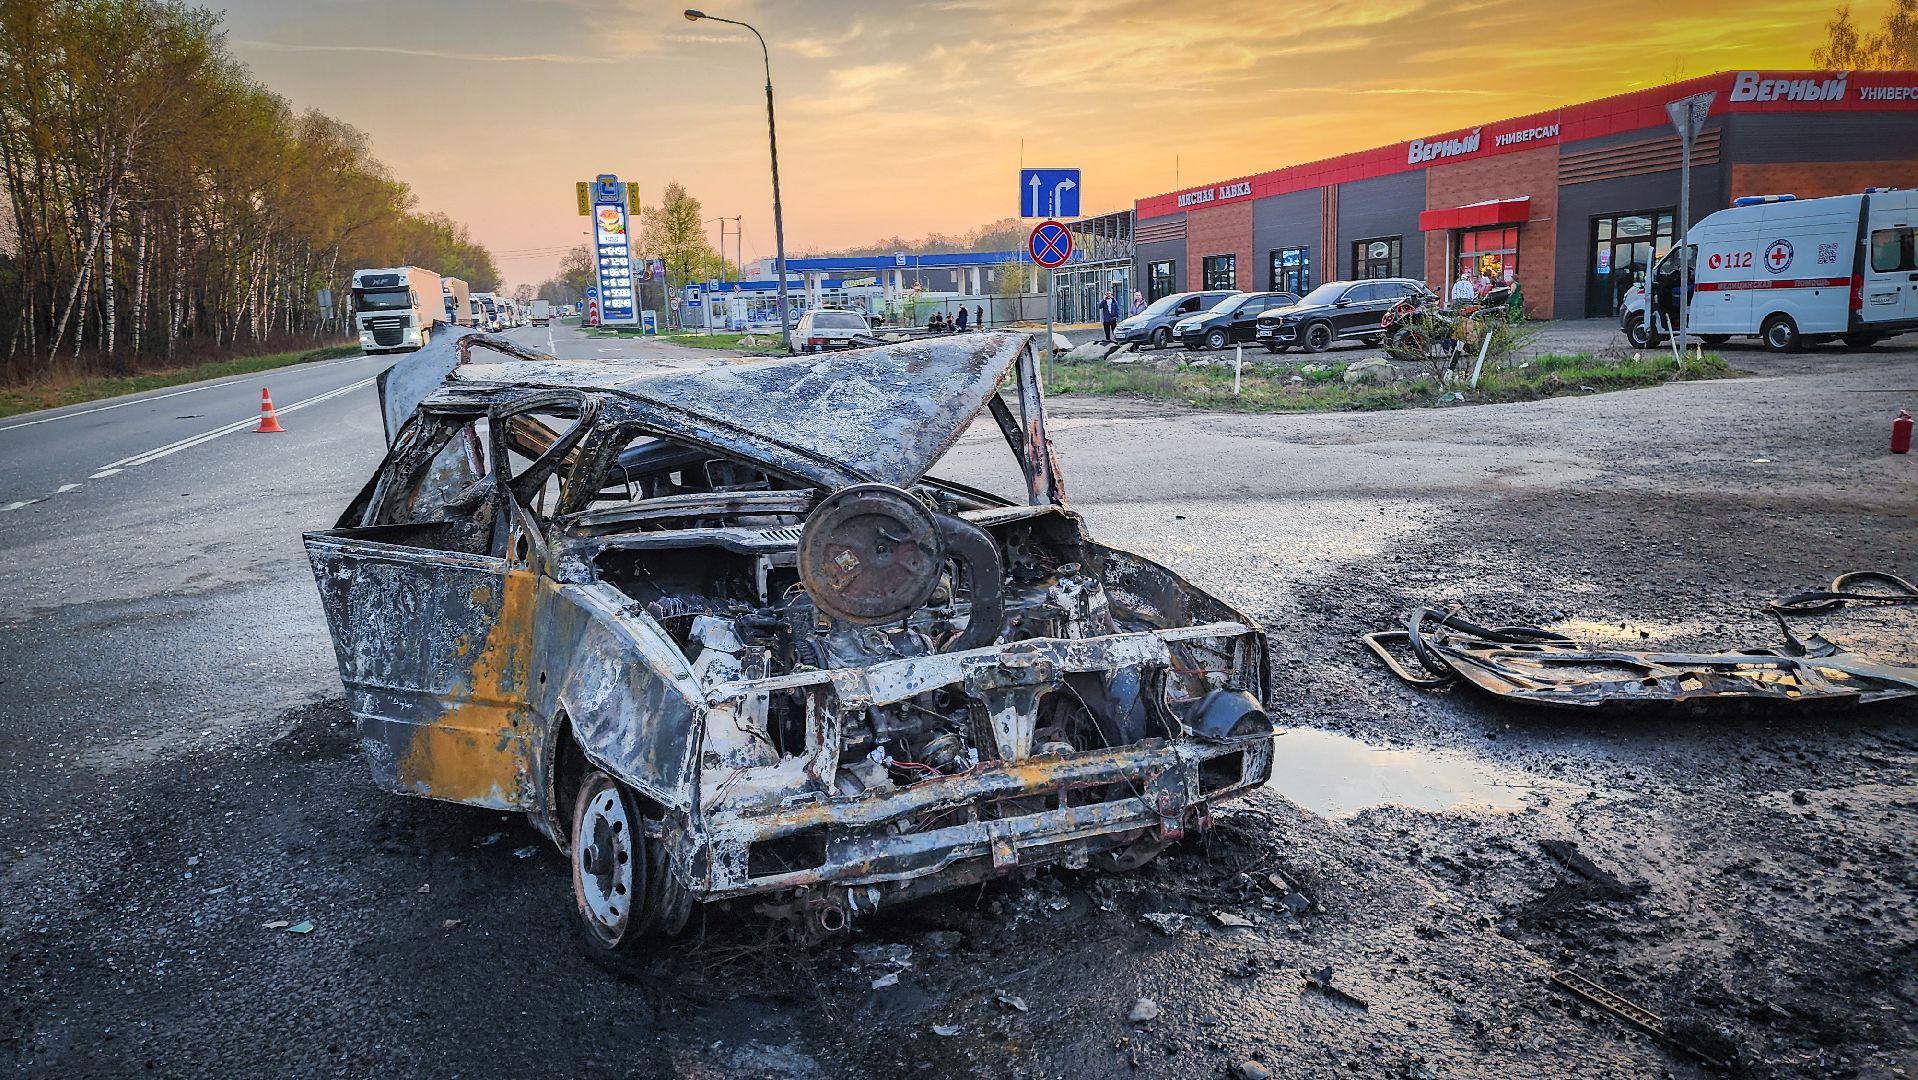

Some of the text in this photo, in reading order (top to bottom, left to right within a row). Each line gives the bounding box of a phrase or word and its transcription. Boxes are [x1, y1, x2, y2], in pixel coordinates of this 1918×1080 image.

[1495, 124, 1559, 147] УНИВЕРСАМ
[1177, 182, 1252, 207] МЯСНАЯ ЛАВКА
[1724, 252, 1752, 269] 112
[1717, 278, 1831, 291] МЕДИЦИНСКАЯ ПОМОЩЬ
